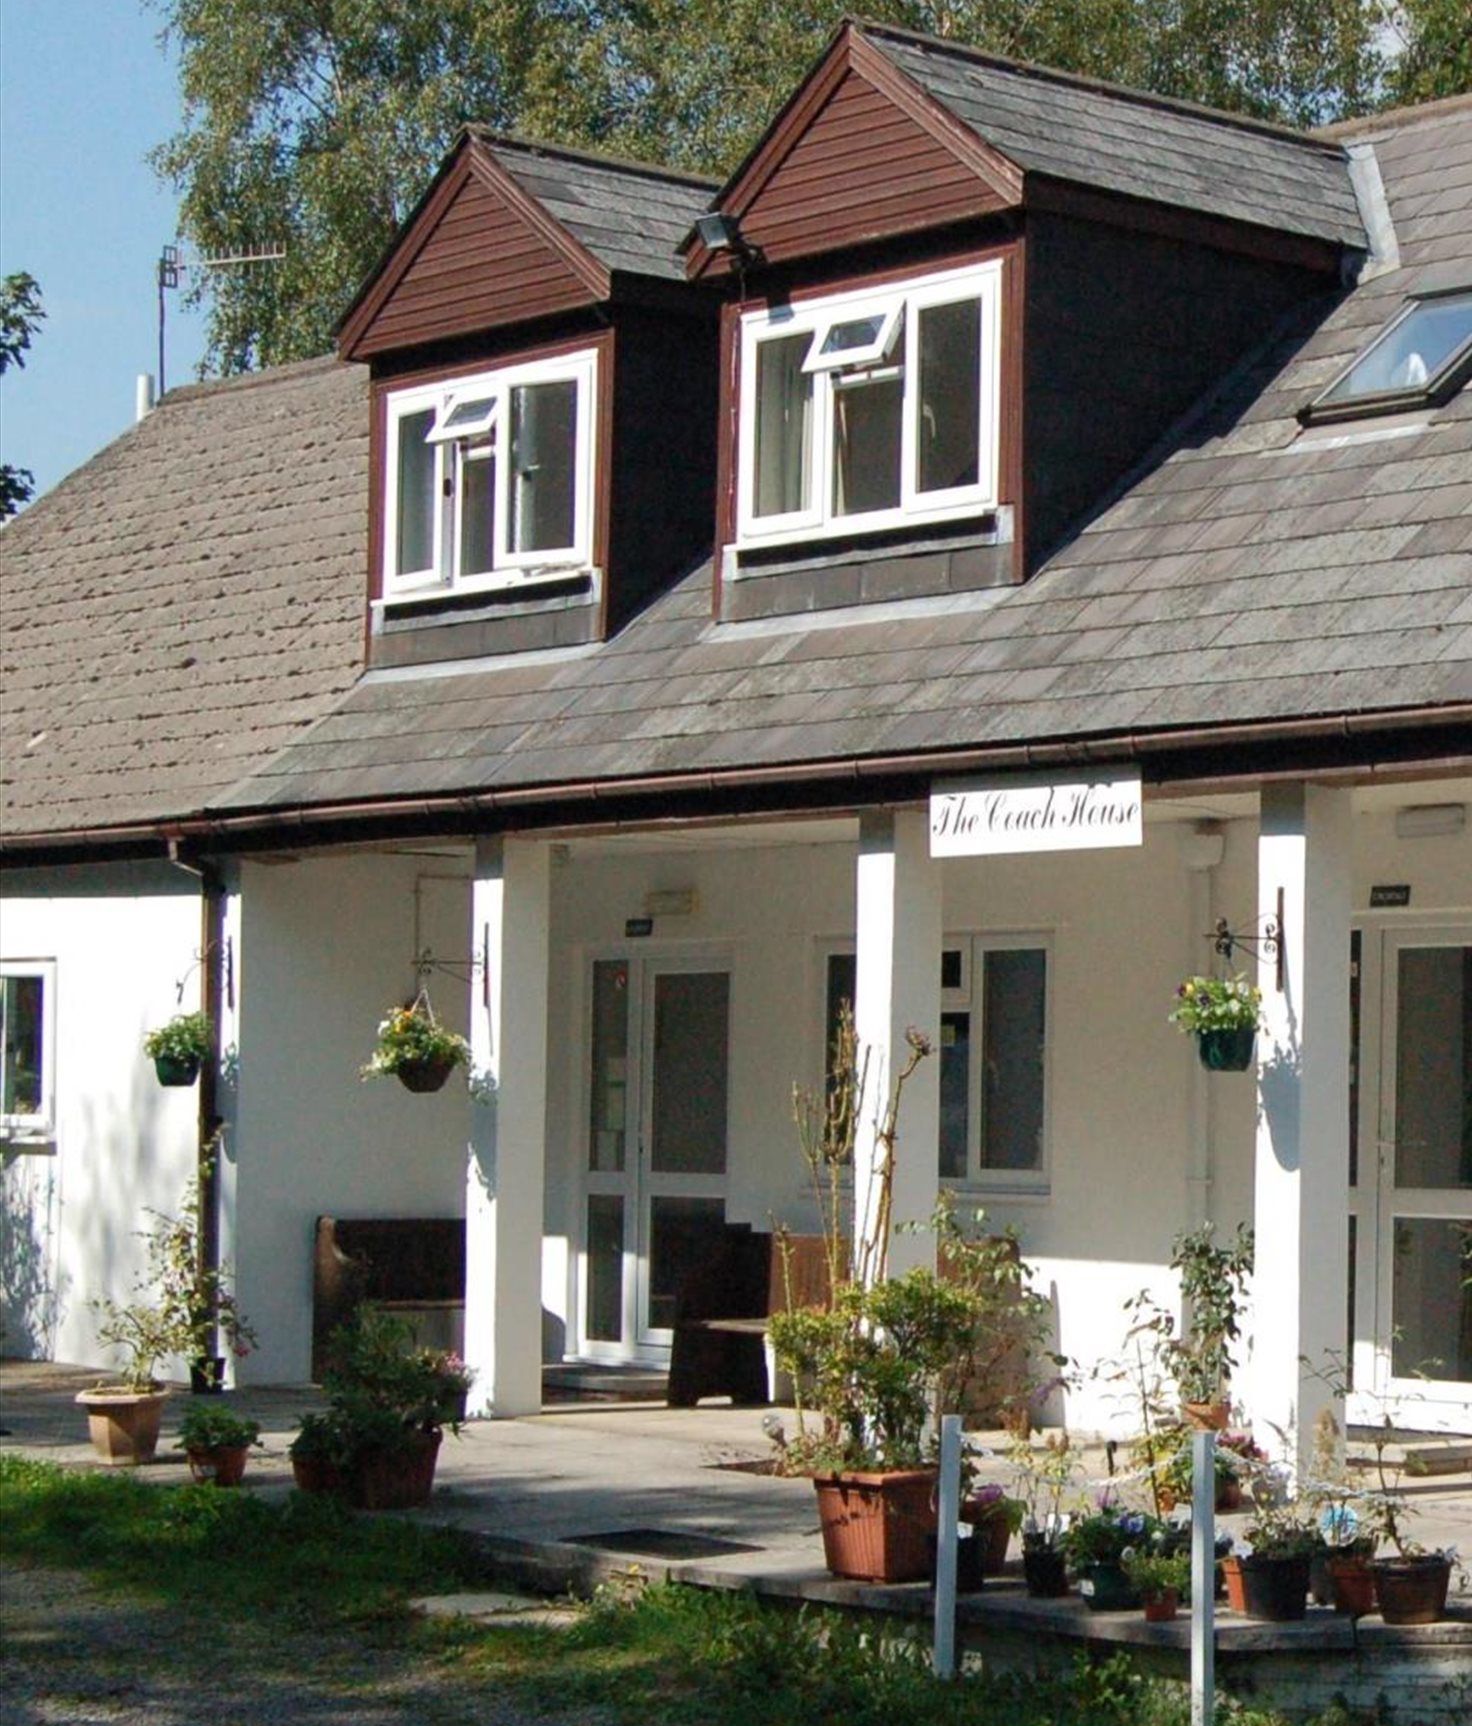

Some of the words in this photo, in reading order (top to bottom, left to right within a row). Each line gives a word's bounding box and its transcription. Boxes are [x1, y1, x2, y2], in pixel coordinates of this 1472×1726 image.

[933, 795, 979, 836] The
[985, 788, 1056, 831] Coach
[1061, 787, 1139, 827] House
